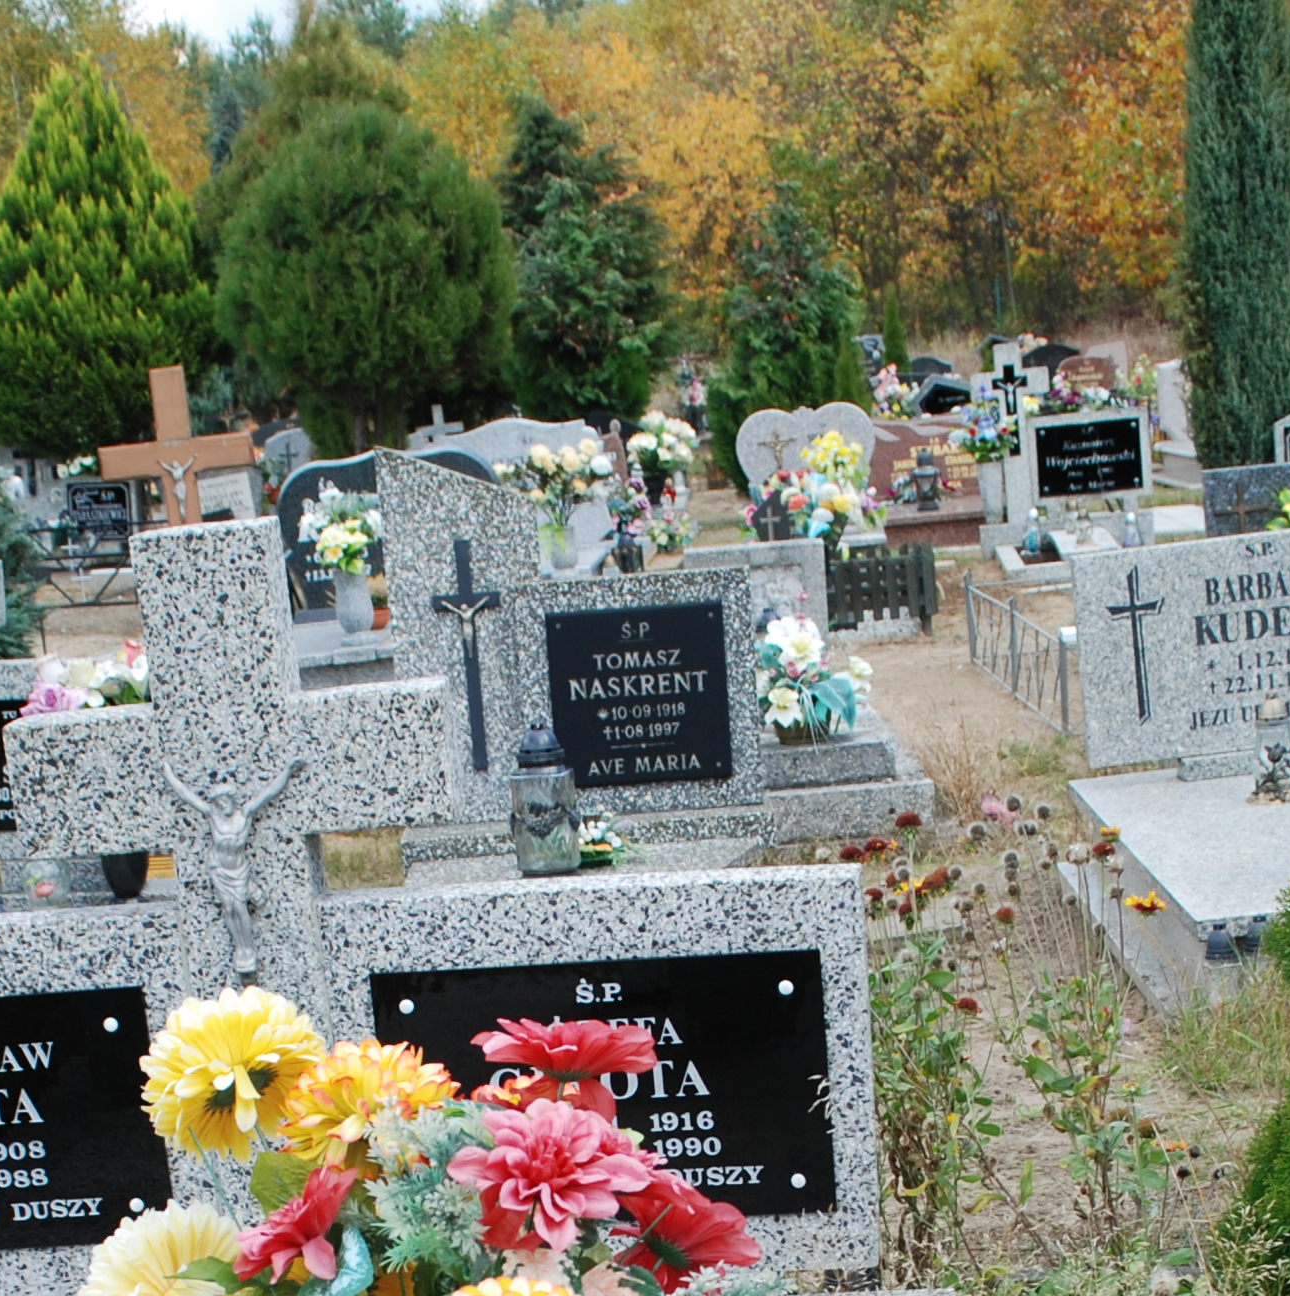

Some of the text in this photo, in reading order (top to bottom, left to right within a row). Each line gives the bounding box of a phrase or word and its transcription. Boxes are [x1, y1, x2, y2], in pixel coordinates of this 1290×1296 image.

[592, 648, 682, 671] TOMASZ
[567, 670, 709, 702] NASKRENT
[1189, 707, 1235, 731] JEZU
[587, 753, 702, 777] AVE MARIA
[489, 1059, 711, 1101] COTA
[649, 1109, 715, 1133] 1916
[653, 1136, 722, 1158] 1990
[11, 1196, 103, 1222] DUSZY
